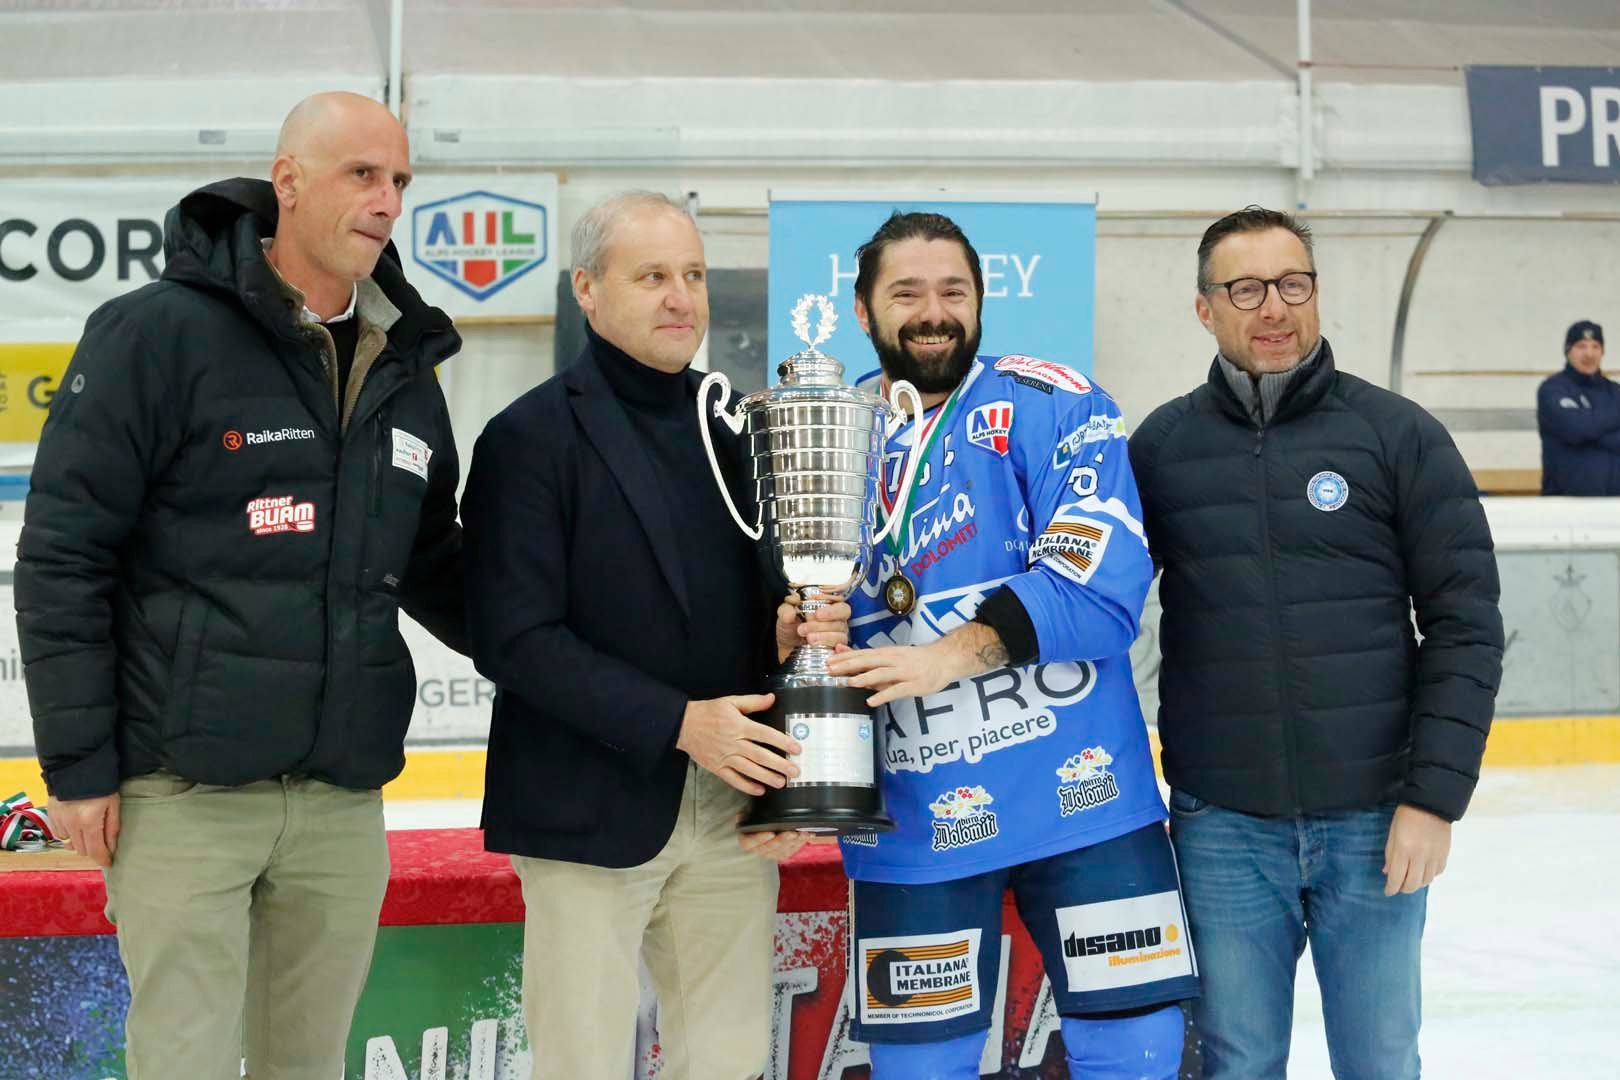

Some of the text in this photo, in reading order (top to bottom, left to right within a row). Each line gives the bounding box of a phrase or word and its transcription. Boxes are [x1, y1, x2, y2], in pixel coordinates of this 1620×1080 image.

[829, 254, 1041, 297] HEY
[246, 427, 316, 445] RaikaRitten
[246, 496, 294, 513] Rittner
[250, 502, 314, 529] BUAM
[911, 521, 978, 577] DOLOMITI
[919, 738, 959, 766] per
[968, 713, 1051, 756] piacere
[1064, 926, 1162, 958] disano
[1108, 947, 1181, 967] illuminazione
[897, 971, 971, 991] MEMBRANE
